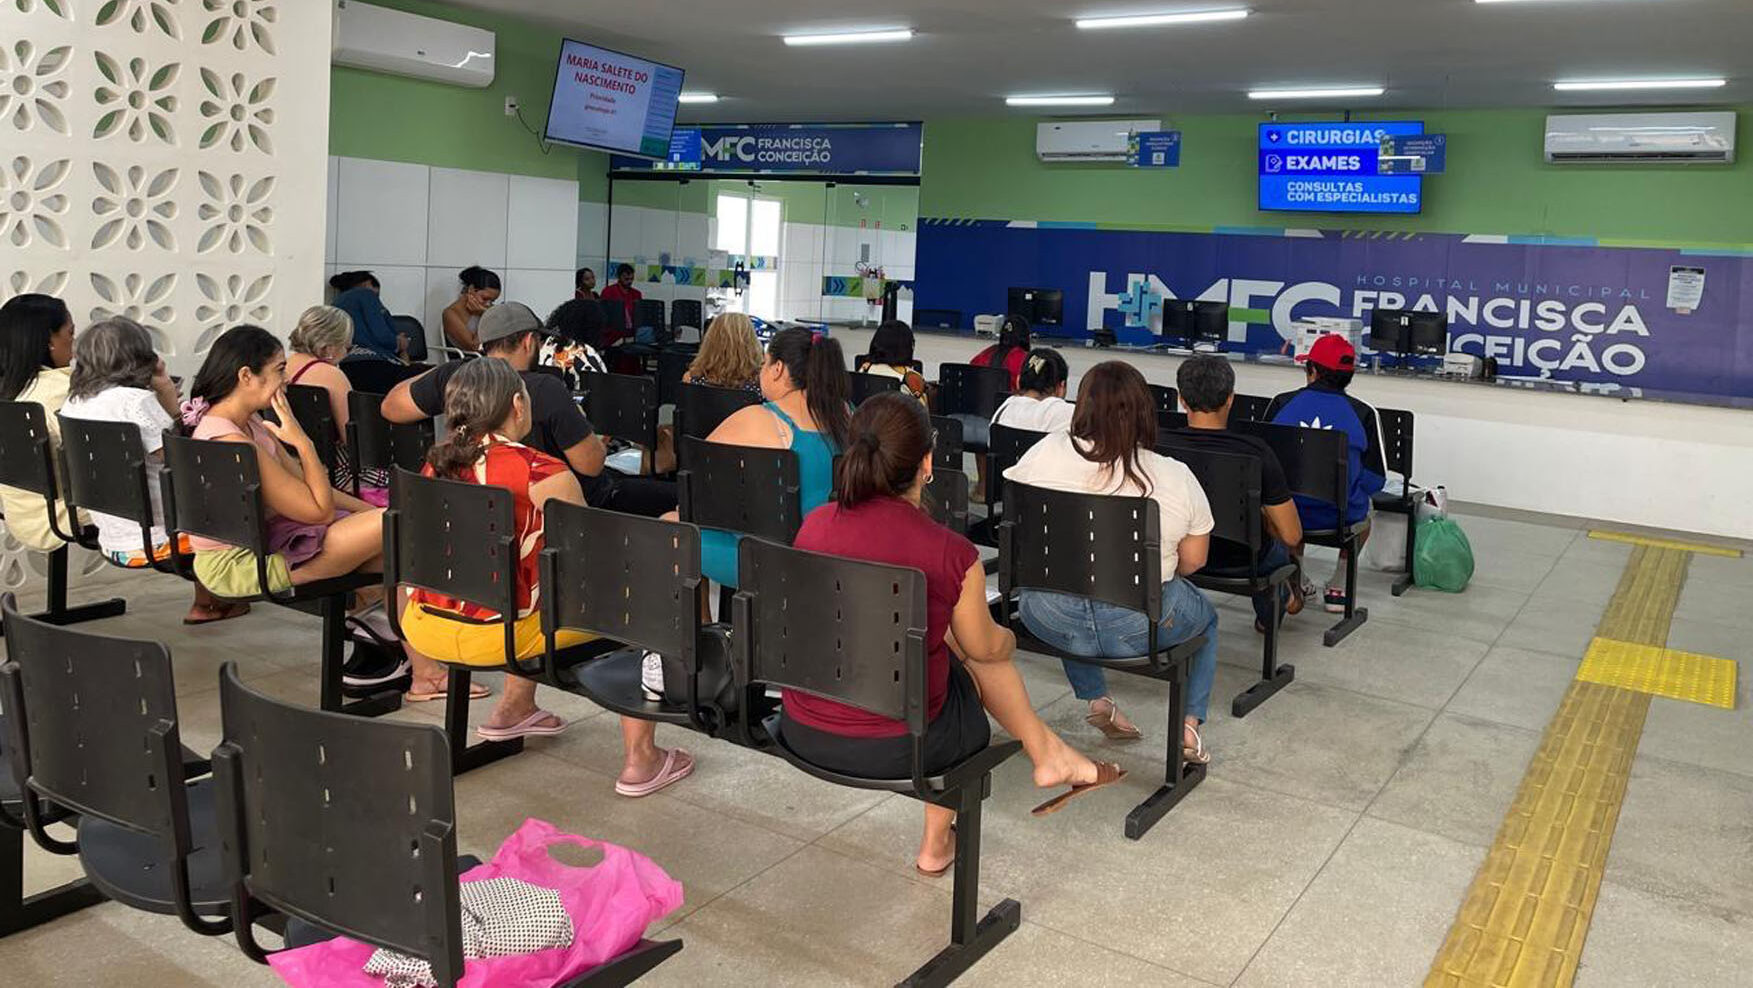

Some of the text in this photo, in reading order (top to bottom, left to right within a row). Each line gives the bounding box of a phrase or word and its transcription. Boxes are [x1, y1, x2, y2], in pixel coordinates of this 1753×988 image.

[566, 54, 648, 83] MARIA SALETE DO
[574, 72, 637, 95] NASCIMENTO
[758, 137, 831, 149] FRANCISCA
[1287, 129, 1386, 144] CIRURGIAS
[701, 136, 755, 162] MFC
[758, 149, 830, 165] CONCEIÇÃO
[1286, 156, 1360, 170] EXAMES
[1287, 182, 1363, 192] CONSULTAS
[1287, 192, 1417, 204] COM ESPECIALISTAS
[1357, 275, 1650, 299] HOSPITAL MUNICIPAL
